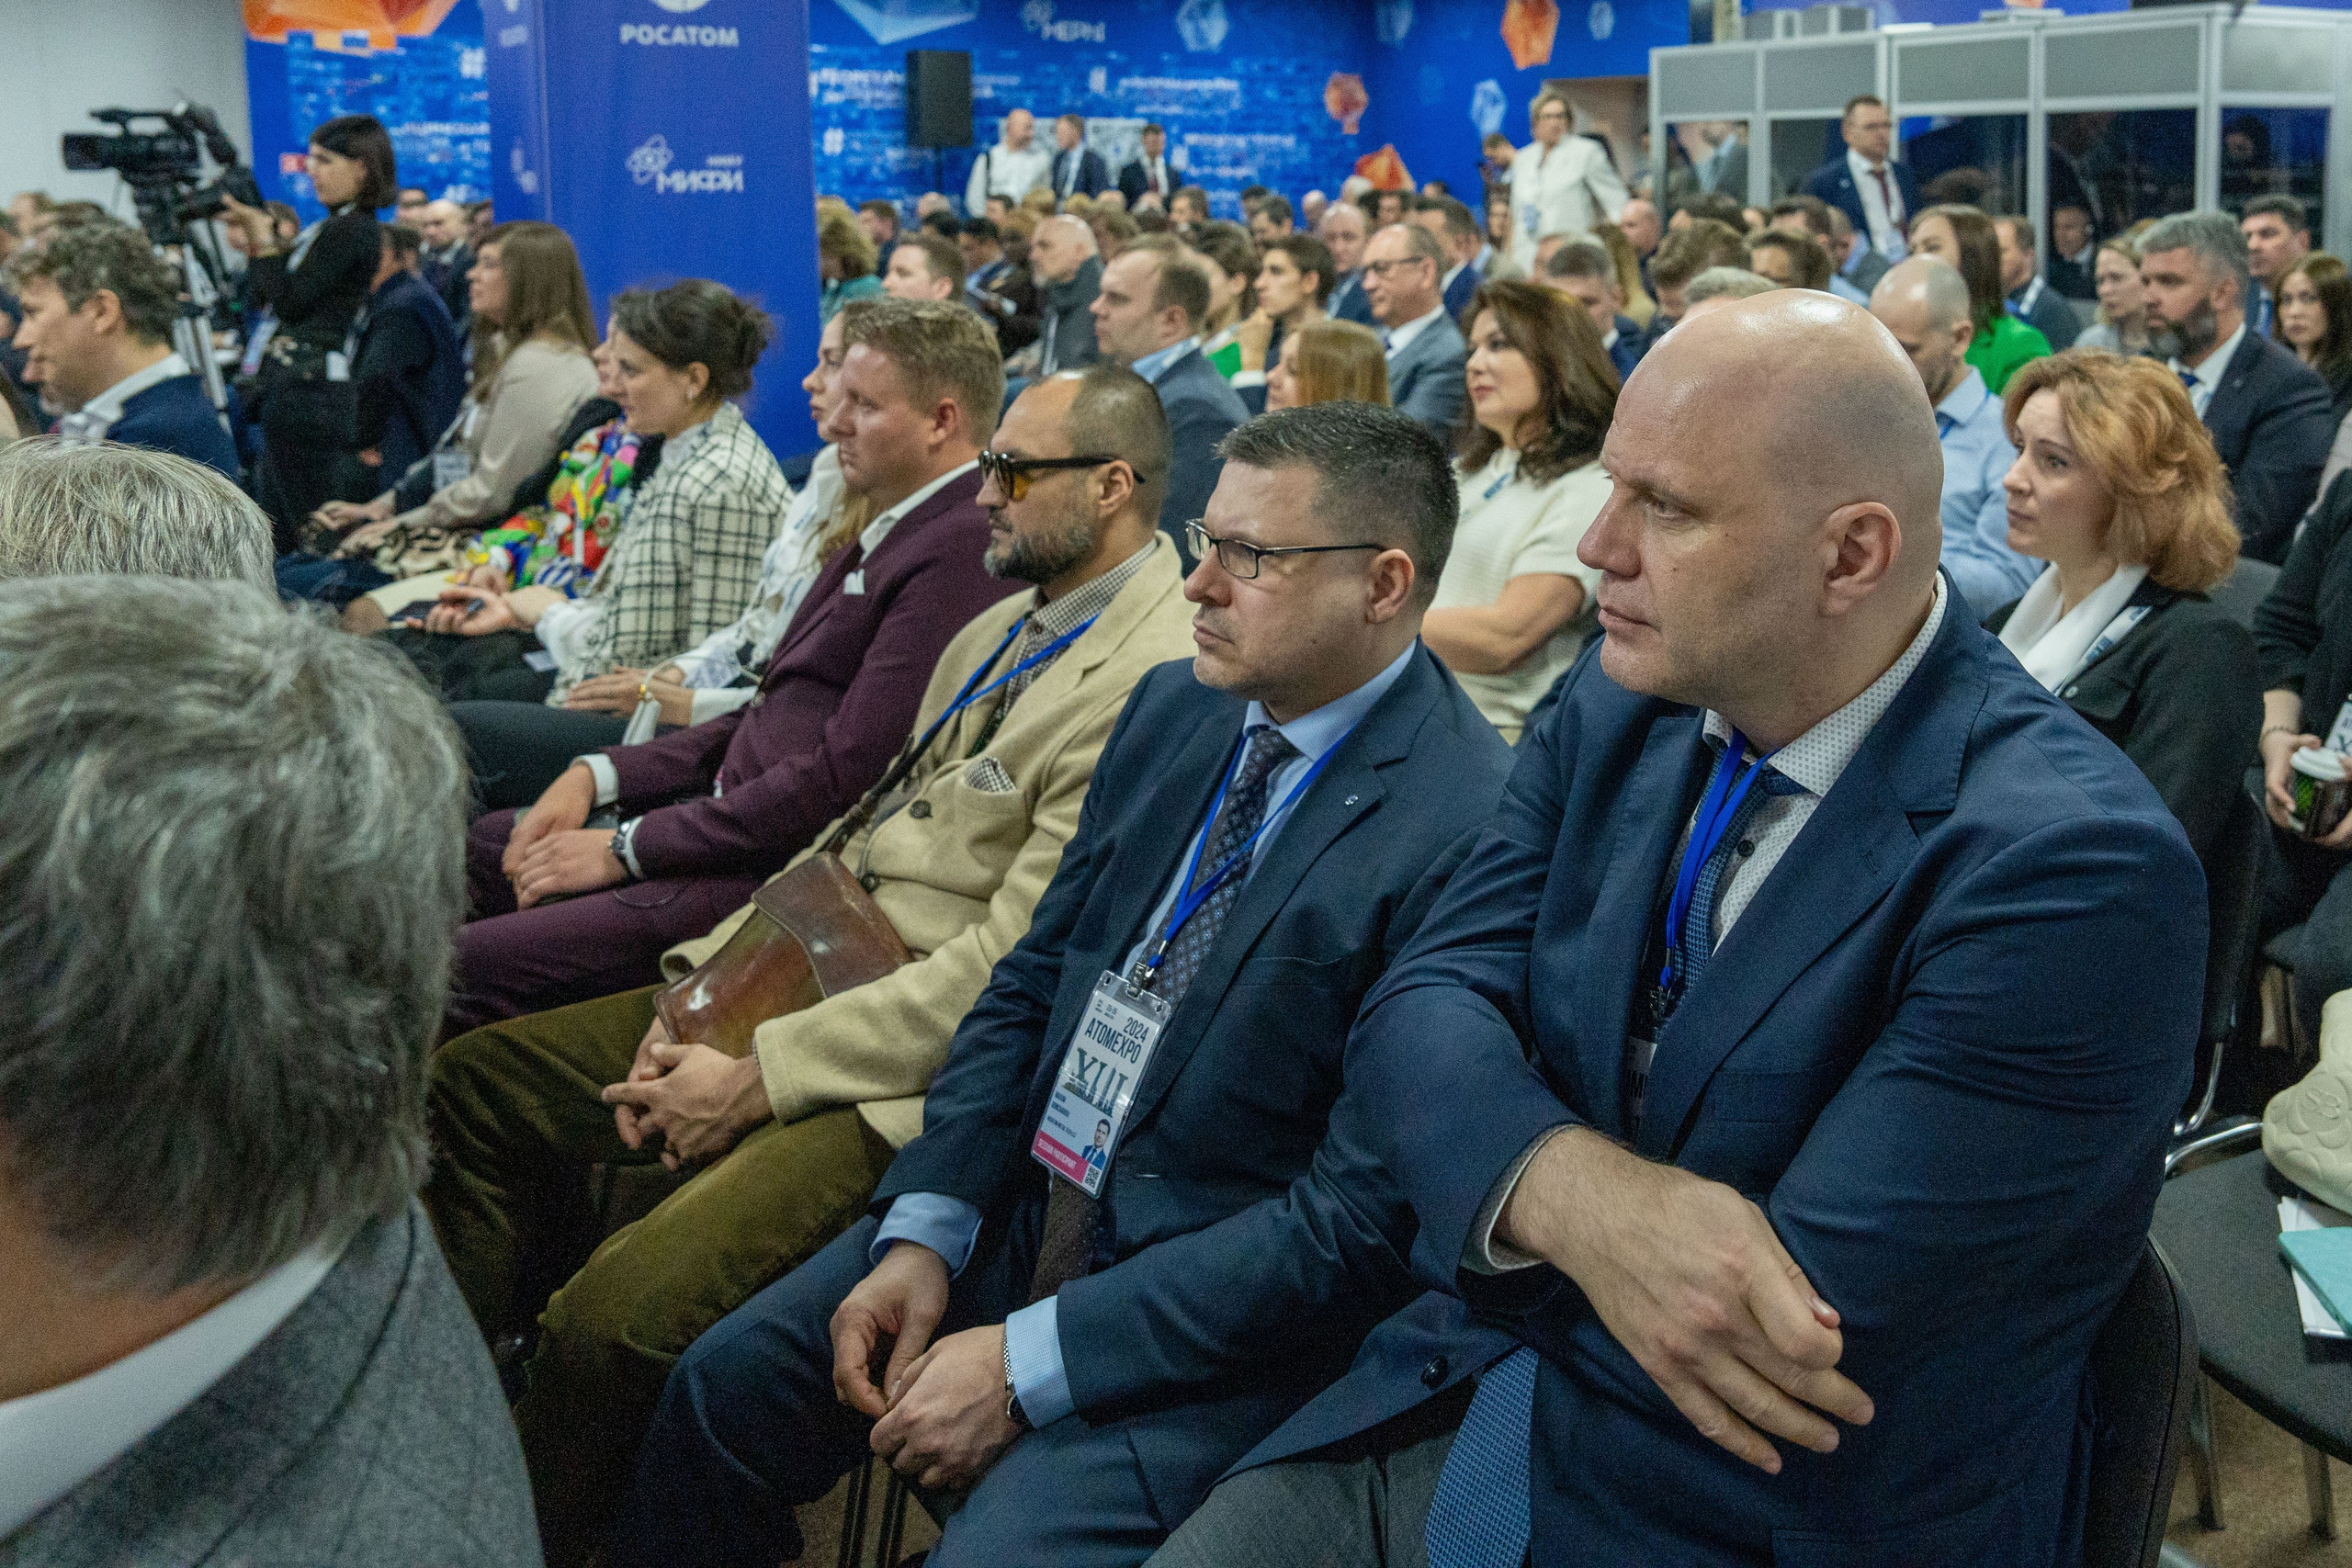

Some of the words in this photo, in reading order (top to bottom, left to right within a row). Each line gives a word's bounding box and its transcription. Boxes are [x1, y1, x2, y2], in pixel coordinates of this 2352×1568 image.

[619, 23, 740, 47] РОСАТОМ
[1084, 1017, 1142, 1064] ATOMEXPO
[1123, 1016, 1149, 1043] 2024
